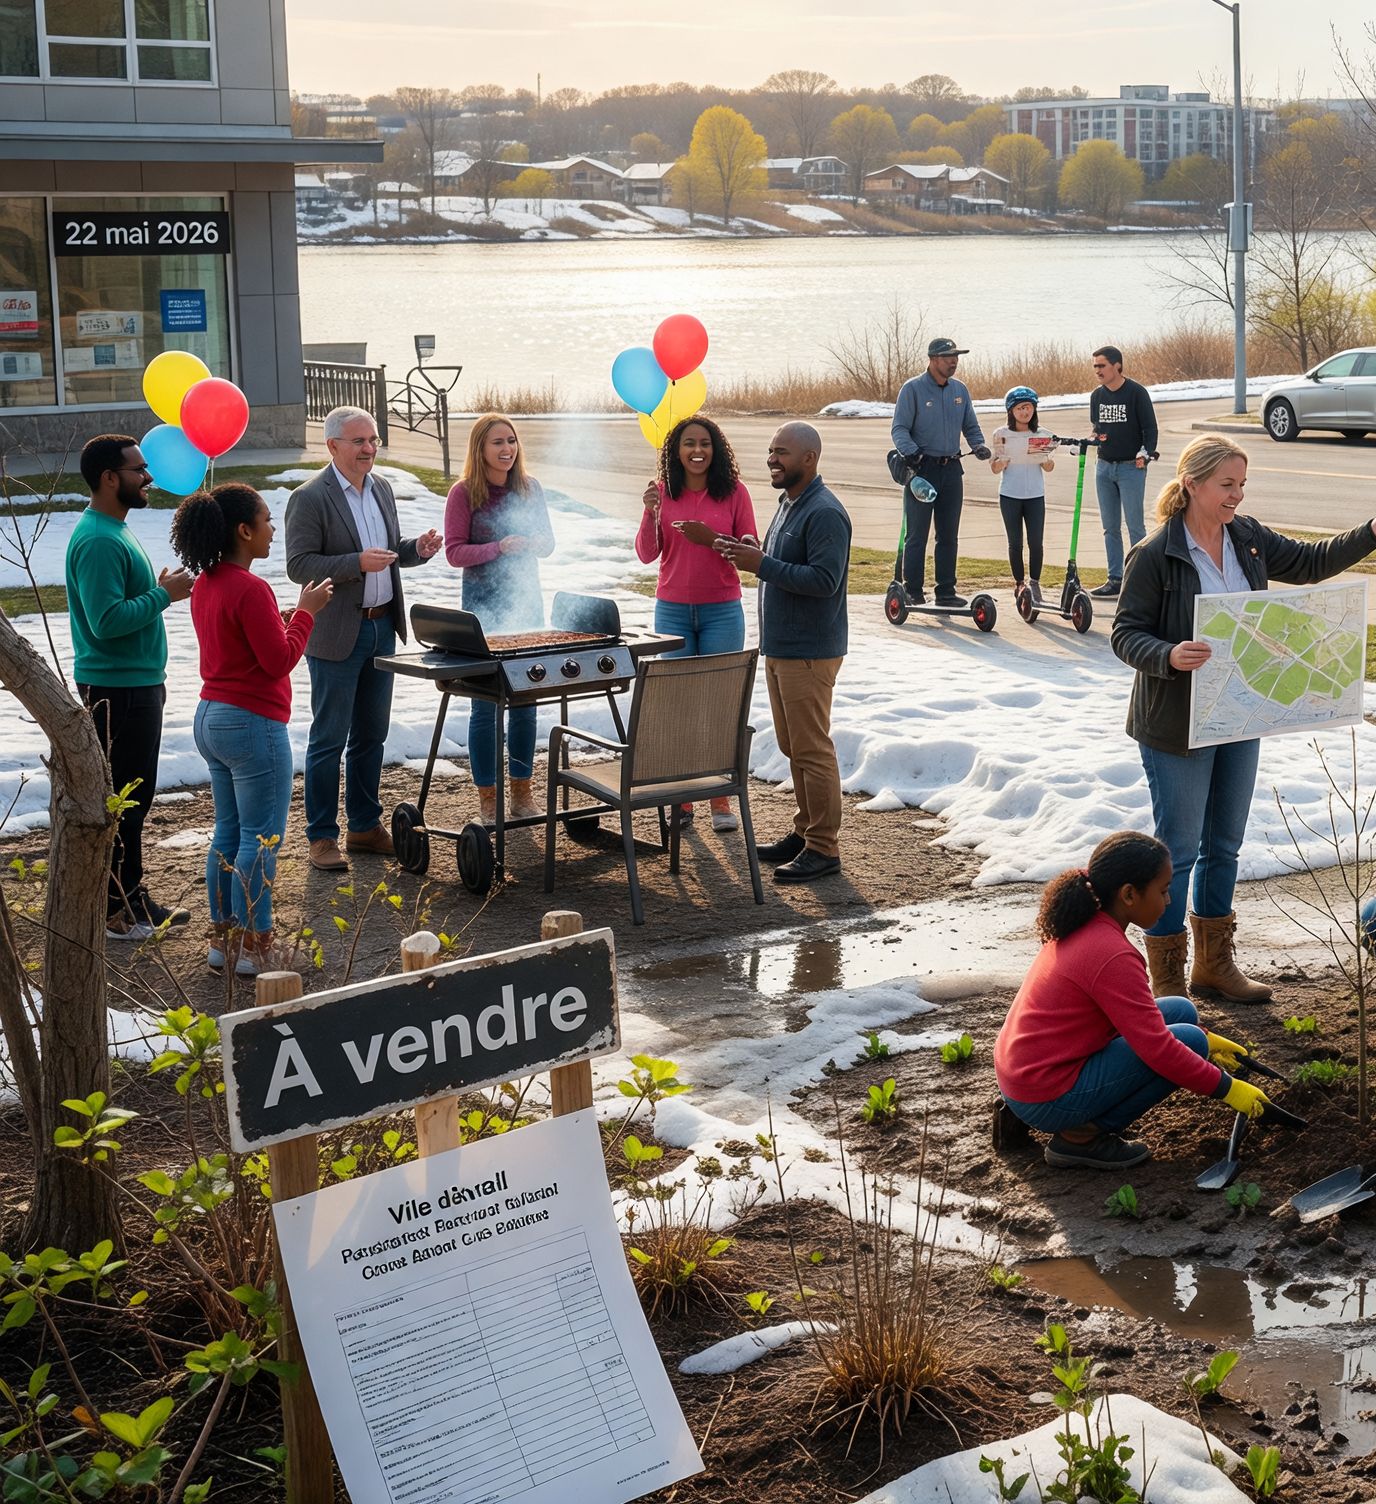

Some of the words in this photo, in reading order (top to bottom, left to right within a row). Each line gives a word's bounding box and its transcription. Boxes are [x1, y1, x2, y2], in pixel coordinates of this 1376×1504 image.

[65, 221, 98, 245] 22
[105, 221, 150, 245] mai
[157, 221, 219, 244] 2026
[262, 1023, 323, 1109] À
[342, 984, 589, 1085] vendre
